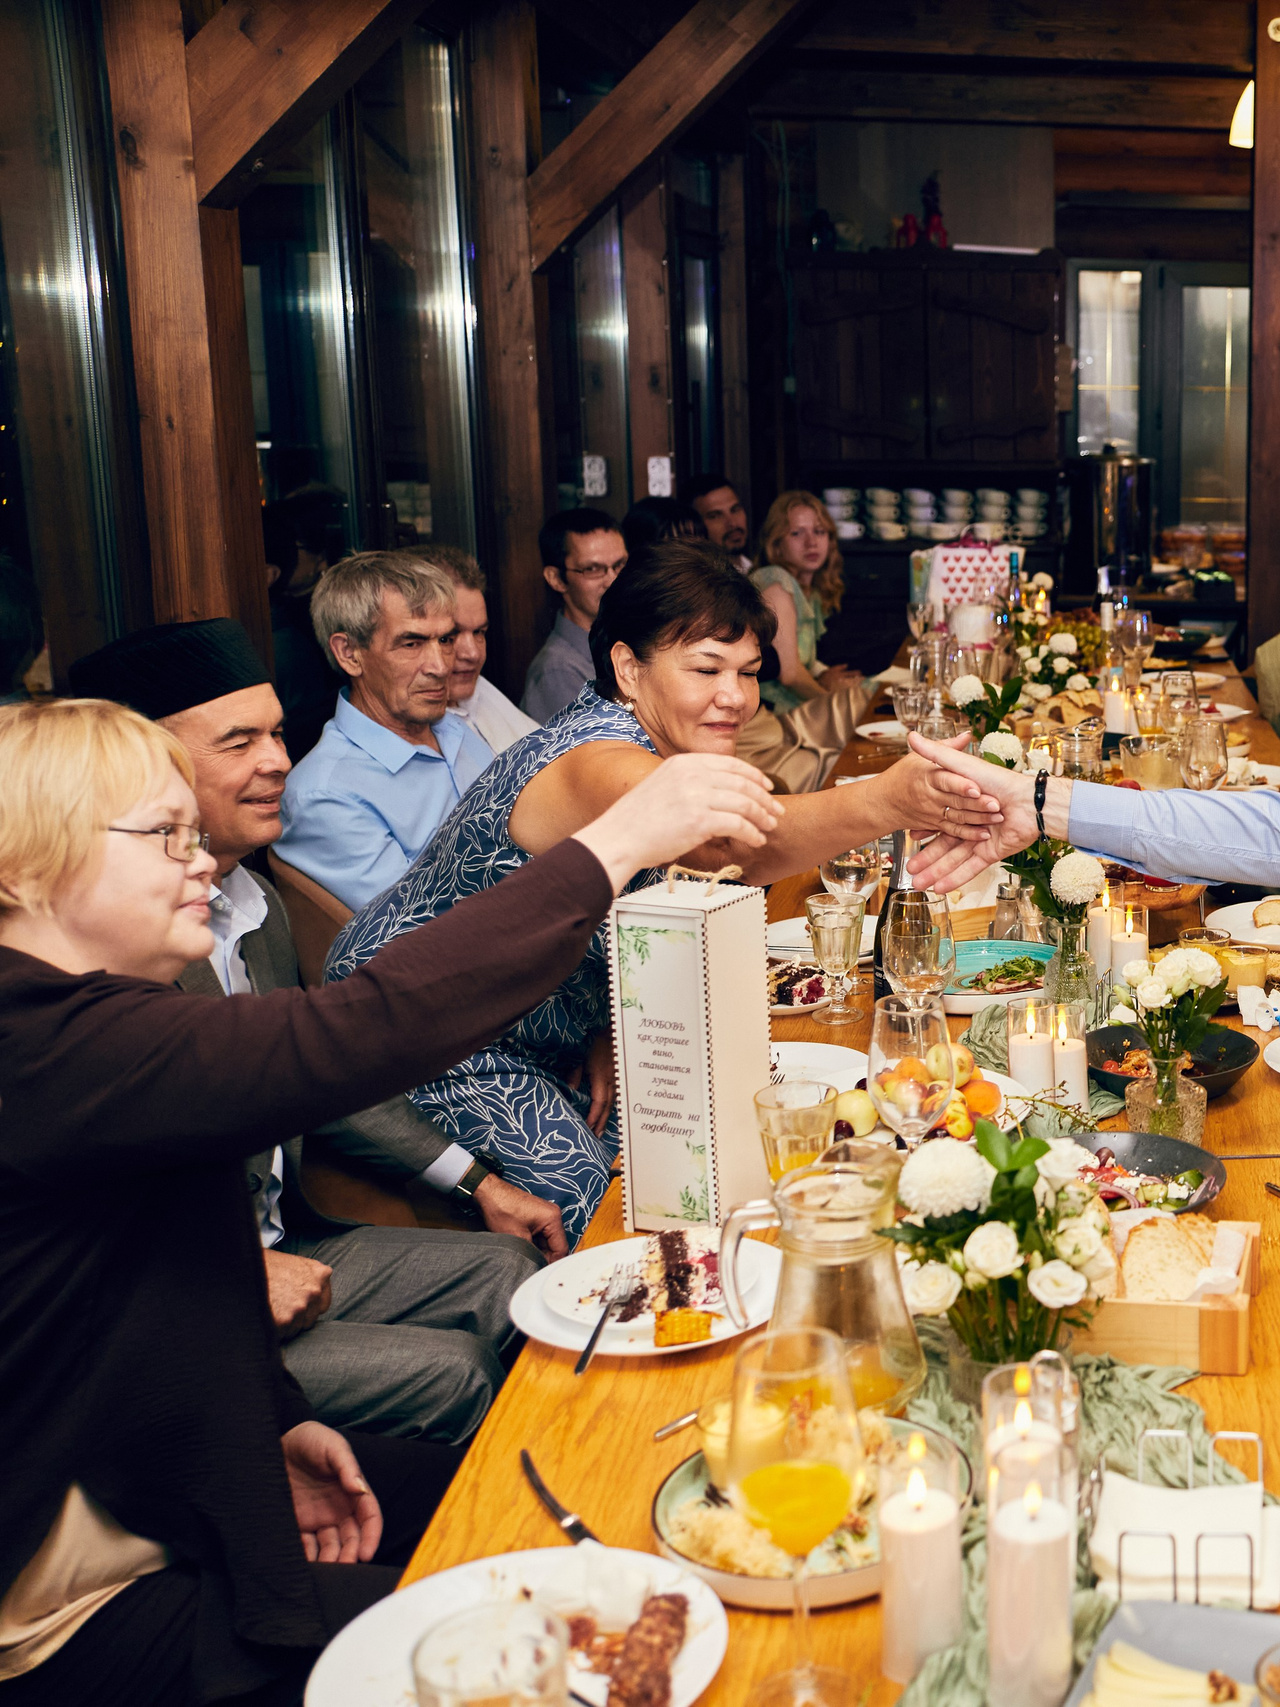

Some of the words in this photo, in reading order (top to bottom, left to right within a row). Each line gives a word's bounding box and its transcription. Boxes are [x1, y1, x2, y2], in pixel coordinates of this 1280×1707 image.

[638, 1018, 685, 1031] ЛЮБОВЬ
[637, 1034, 654, 1044] как
[653, 1036, 690, 1046] хорошее
[652, 1050, 674, 1059] вино,
[638, 1061, 691, 1074] становится
[651, 1077, 678, 1087] лучше
[653, 1089, 684, 1100] годами
[633, 1103, 682, 1119] Открыть
[687, 1114, 700, 1122] на
[640, 1122, 695, 1138] годовщину
